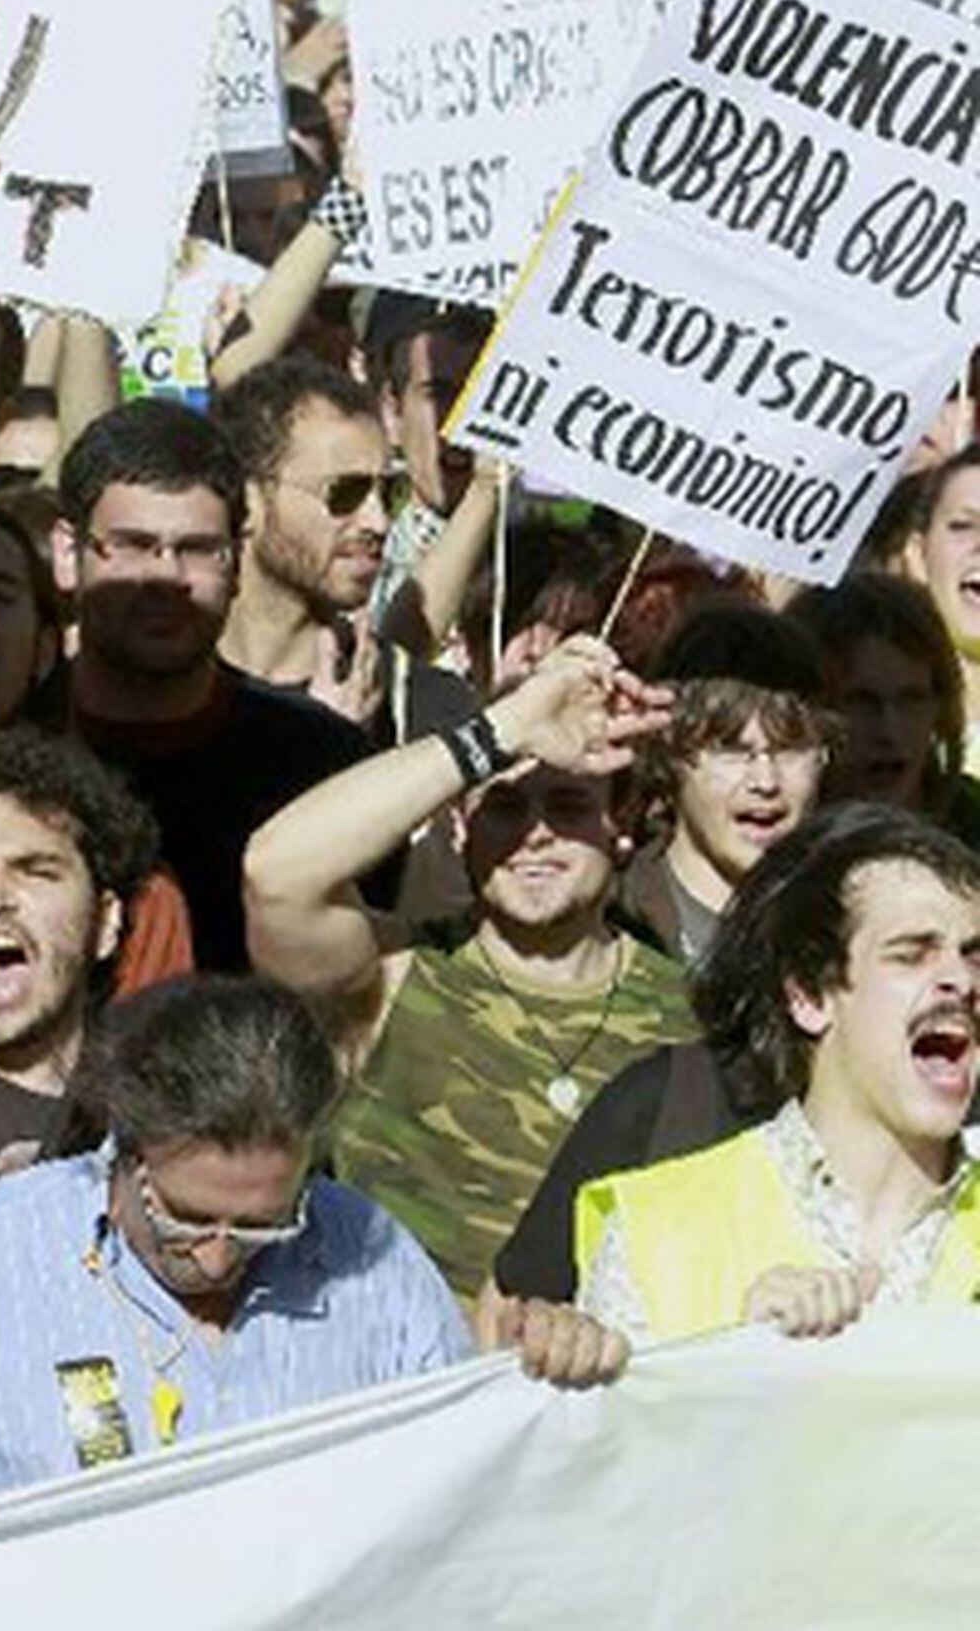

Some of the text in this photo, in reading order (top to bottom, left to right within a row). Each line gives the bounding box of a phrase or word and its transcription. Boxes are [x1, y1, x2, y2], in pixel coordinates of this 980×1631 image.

[610, 77, 849, 260] COBRAR
[548, 219, 909, 462] Terrorismo,
[482, 354, 878, 564] ni económico!
